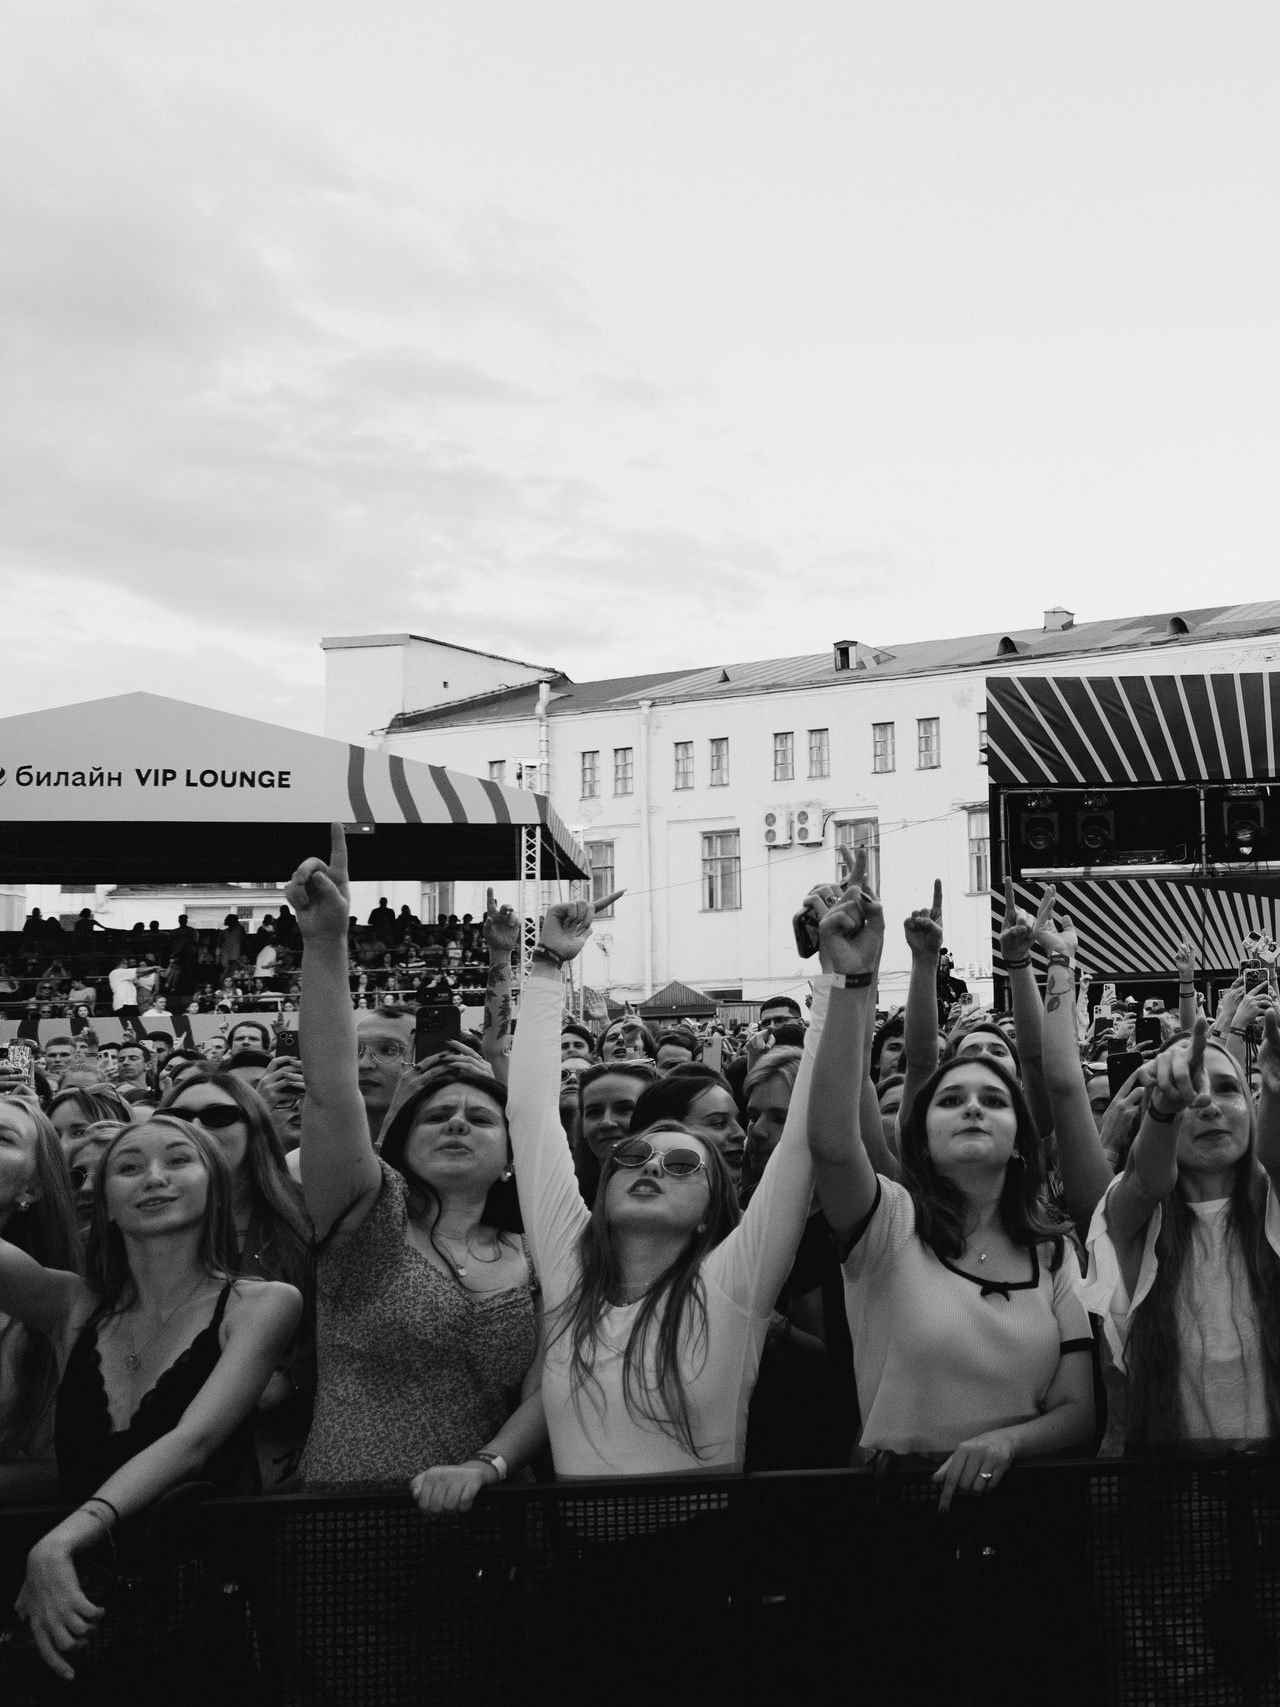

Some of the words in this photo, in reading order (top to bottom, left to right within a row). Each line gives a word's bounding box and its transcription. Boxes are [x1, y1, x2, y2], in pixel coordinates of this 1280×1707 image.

[15, 765, 123, 787] билайн
[135, 768, 177, 787] VIP
[185, 769, 291, 788] LOUNGE
